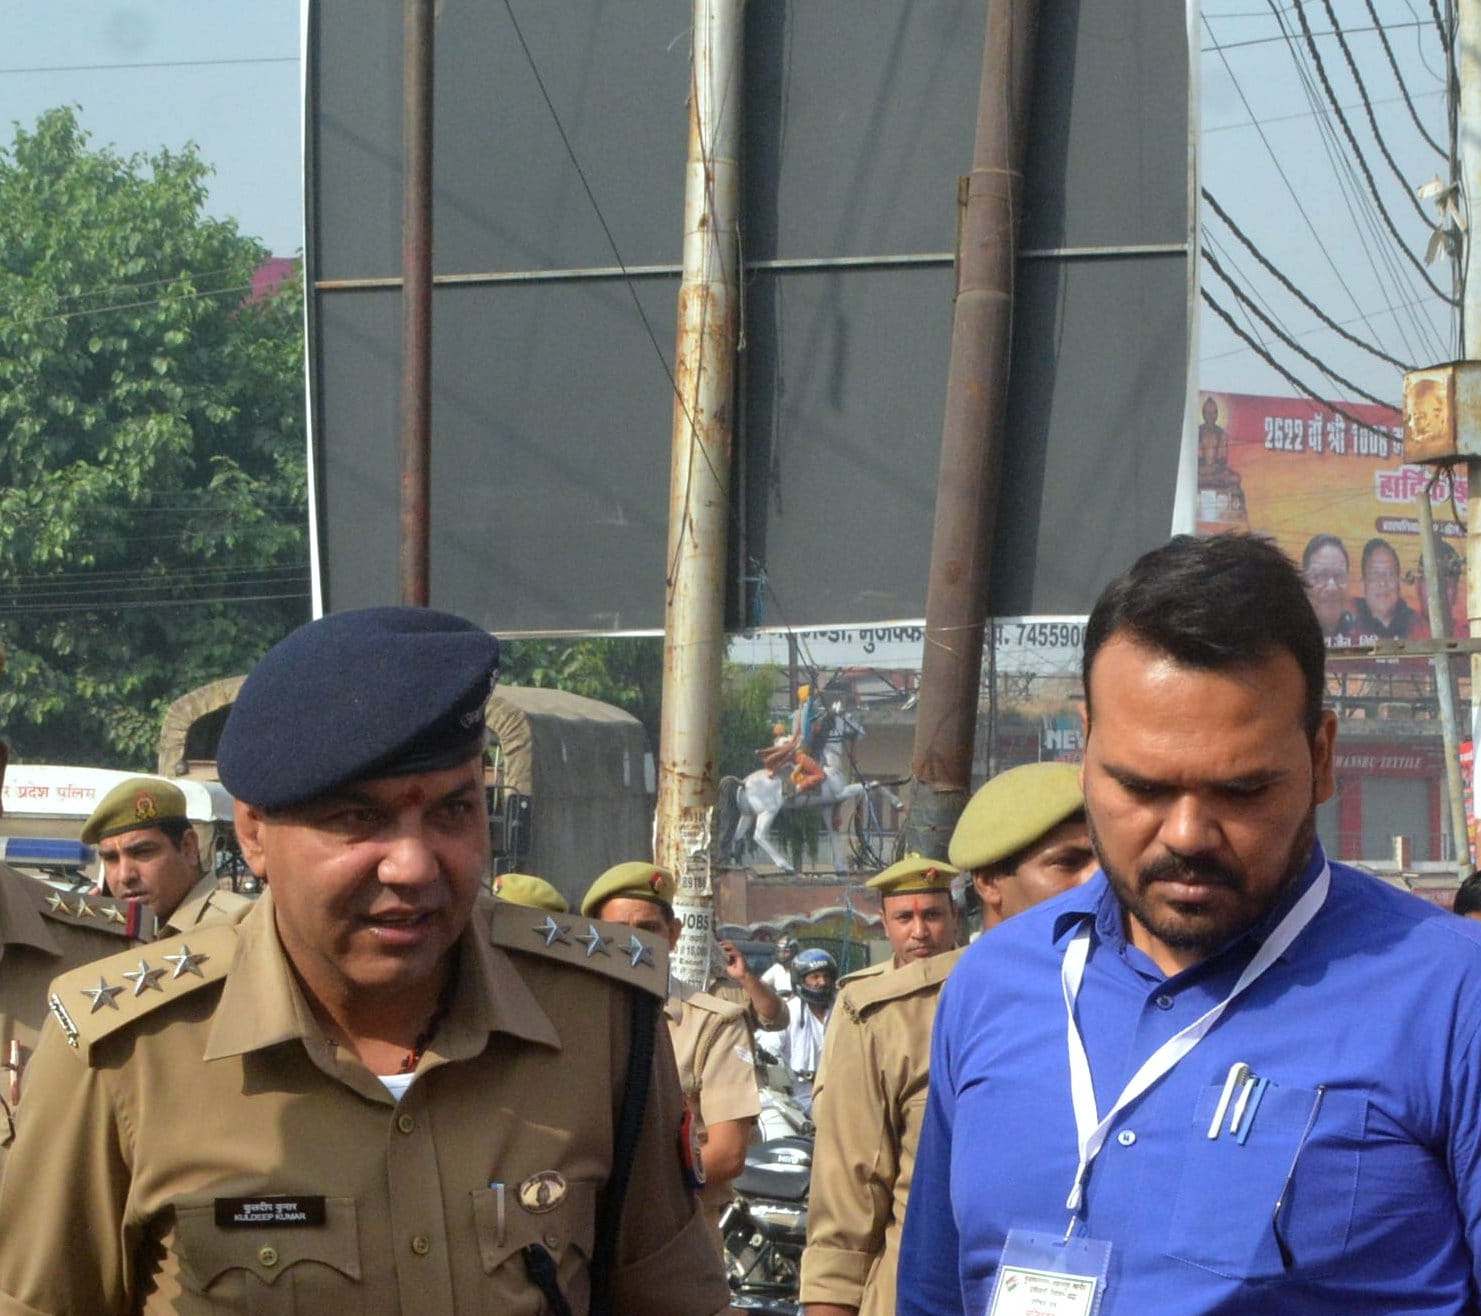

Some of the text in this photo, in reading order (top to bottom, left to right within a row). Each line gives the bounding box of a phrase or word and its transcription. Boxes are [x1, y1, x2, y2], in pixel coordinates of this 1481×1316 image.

[1265, 417, 1303, 451] 2622
[1327, 413, 1345, 454] श्री
[1379, 755, 1422, 769] TEXTILE
[16, 783, 49, 799] प्रदेश
[56, 783, 96, 801] पुलिस
[682, 913, 709, 930] JOBS
[242, 1201, 298, 1214] कुलदीप कुमार
[234, 1212, 306, 1221] KULDEEP KUMAR
